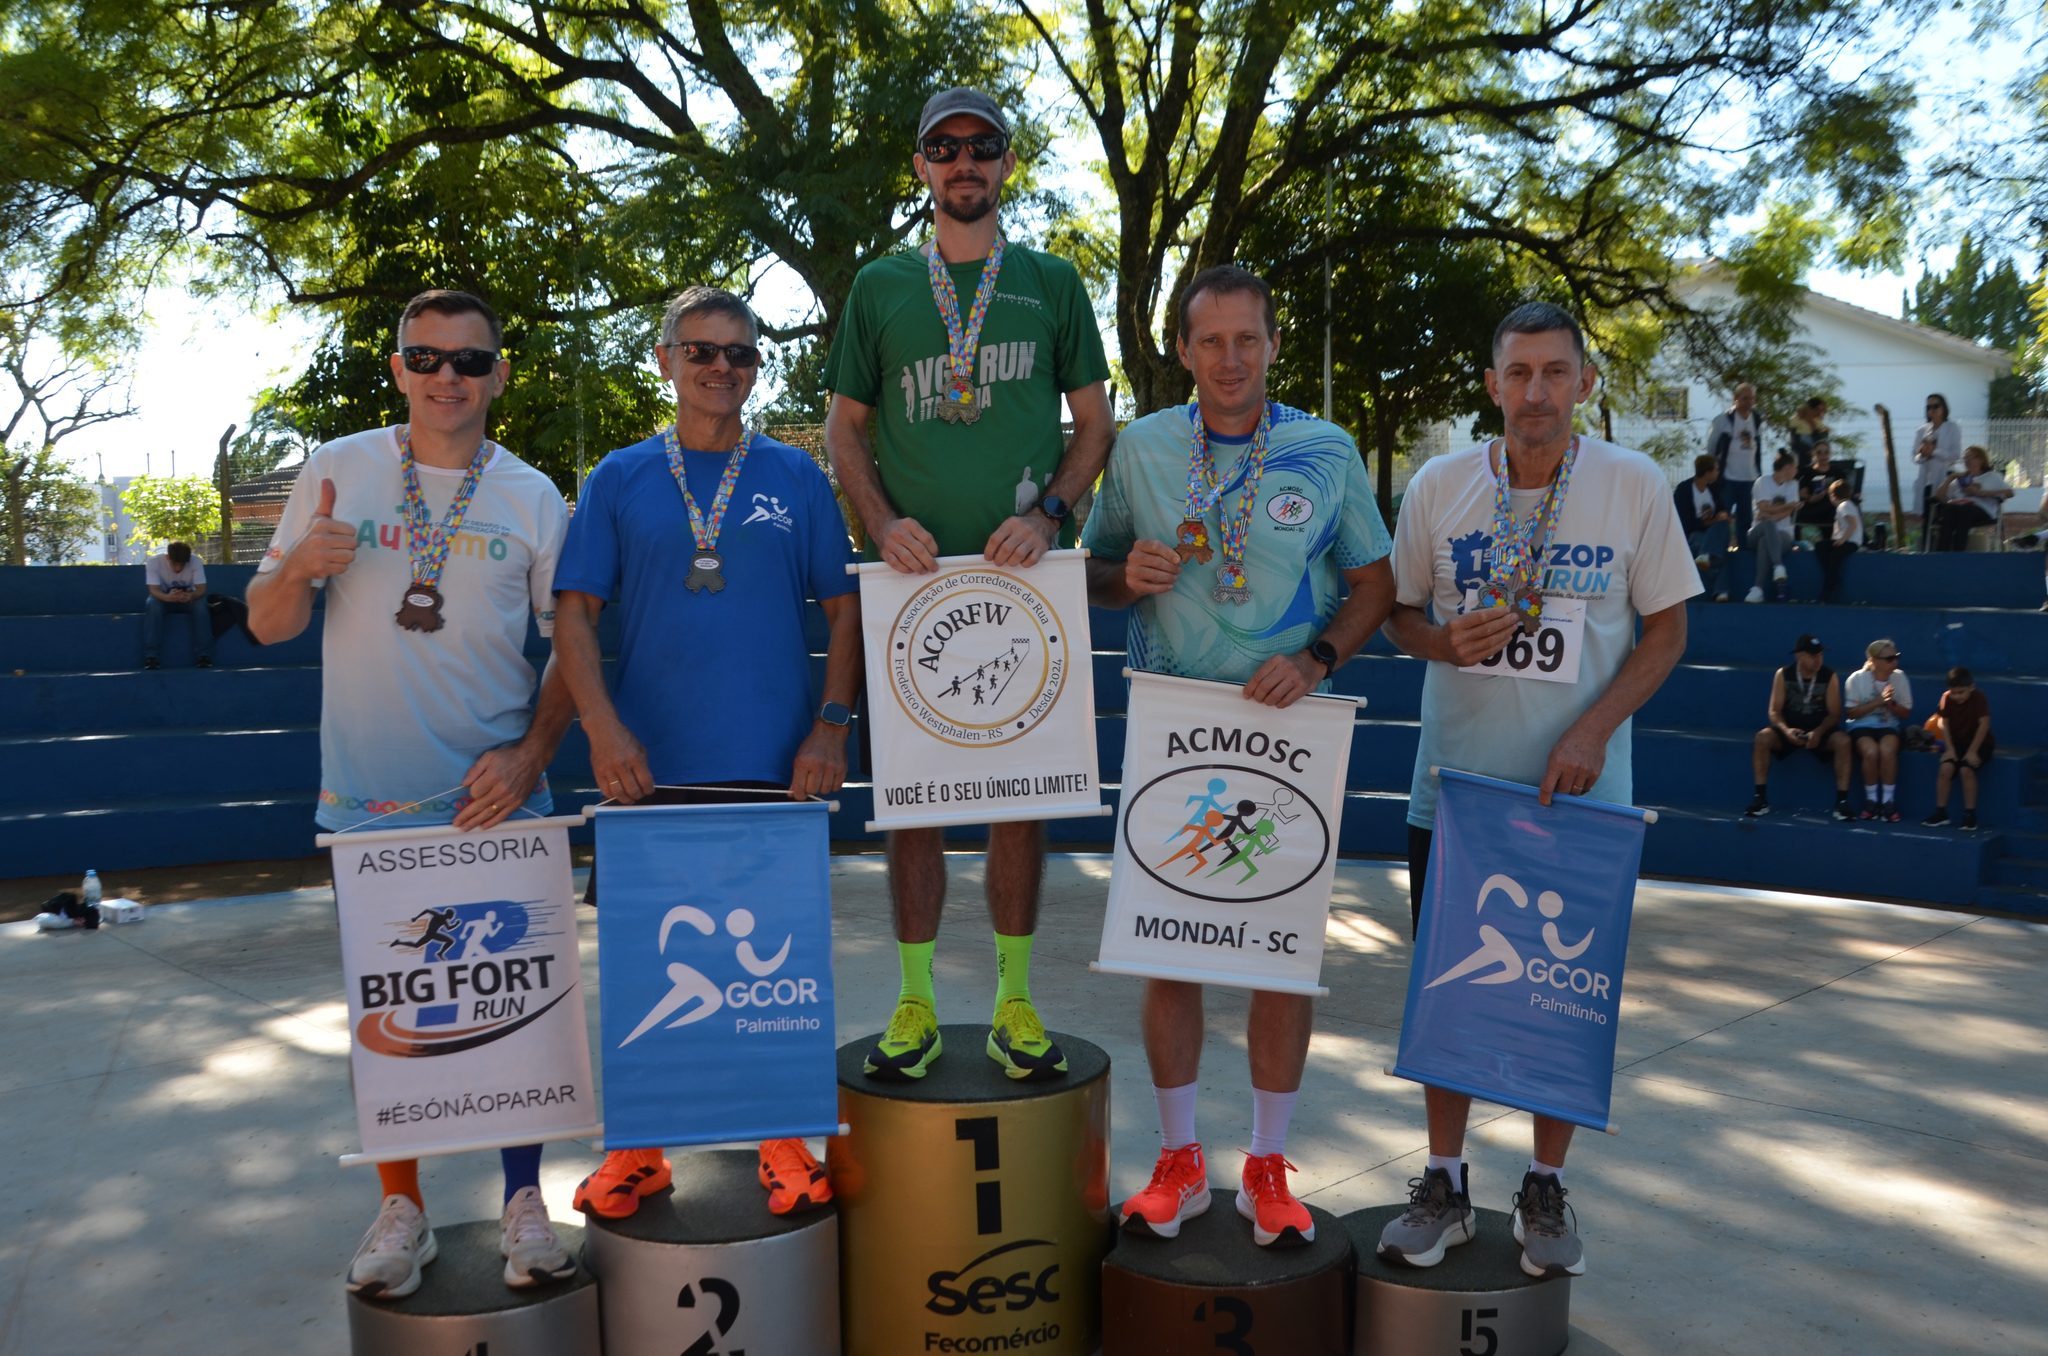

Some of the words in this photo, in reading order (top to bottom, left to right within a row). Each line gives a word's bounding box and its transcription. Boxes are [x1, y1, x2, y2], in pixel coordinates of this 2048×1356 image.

[996, 292, 1041, 305] EVOLUTION
[979, 341, 1037, 385] RUN
[357, 519, 507, 561] Aumo
[770, 512, 793, 527] GCOR
[899, 584, 944, 634] Associação
[945, 578, 959, 589] de
[960, 574, 1022, 595] Corredores
[1021, 592, 1035, 605] de
[1032, 603, 1049, 625] Rua
[917, 601, 1012, 673] ACORFW
[894, 658, 920, 711] Frederico
[1028, 689, 1055, 719] Desde
[1049, 659, 1063, 688] 2024
[1166, 726, 1312, 773] ACMOSC
[885, 782, 924, 806] VOCÊ
[927, 781, 936, 803] É
[940, 783, 949, 802] O
[954, 781, 982, 801] SEU
[986, 776, 1030, 799] ÚNICO
[1034, 773, 1088, 795] LIMITE!
[358, 836, 549, 875] ASSESSORIA
[1134, 915, 1249, 949] MONDAÍ
[1267, 930, 1299, 954] SC
[360, 968, 436, 1010] BIG
[447, 954, 556, 999] FORT
[725, 978, 819, 1009] GCOR
[1526, 957, 1611, 1000] GCOR
[473, 996, 526, 1021] RUN
[735, 1016, 820, 1034] Palmitinho
[1530, 993, 1607, 1025] Palmitinho
[376, 1085, 577, 1126] #ÉSÓNÃOPARAR
[955, 1116, 1002, 1235] 1
[677, 1277, 746, 1356] 2
[1193, 1296, 1255, 1356] 3
[1460, 1308, 1499, 1356] 5
[925, 1322, 1061, 1354] Fecomércio
